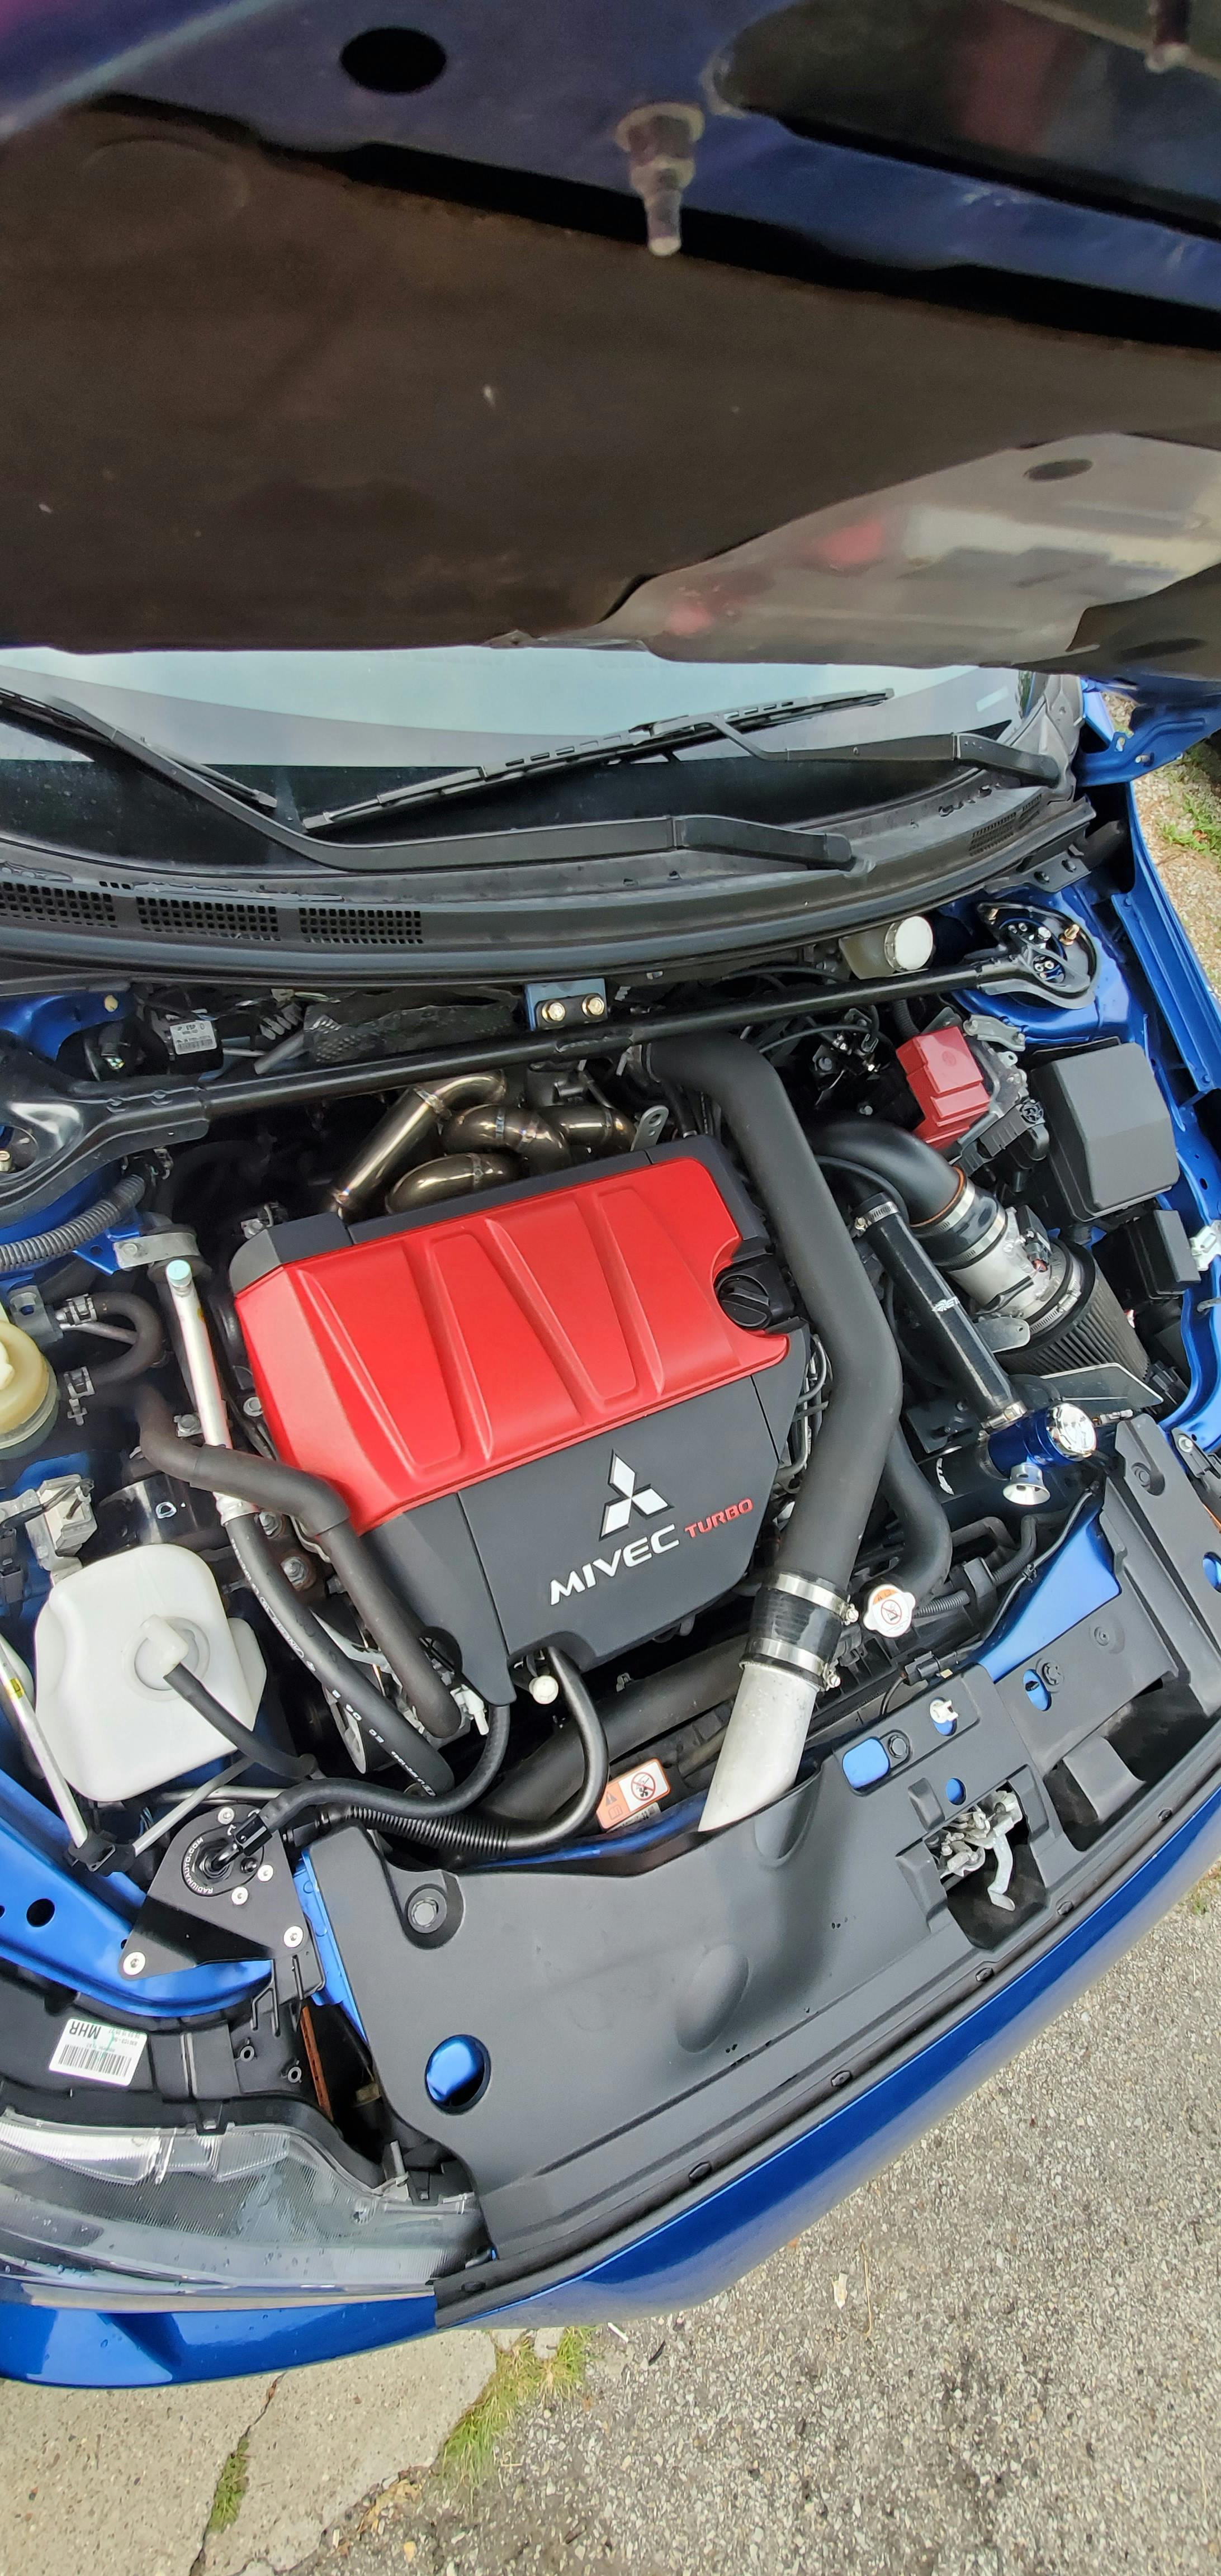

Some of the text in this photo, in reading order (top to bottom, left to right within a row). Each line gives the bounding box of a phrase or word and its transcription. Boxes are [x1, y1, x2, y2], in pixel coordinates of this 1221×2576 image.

[550, 1498, 754, 1606] MIVEC TURBO
[184, 1836, 214, 1894] RADIUMAUTO.COM
[69, 2021, 102, 2040] MHR
